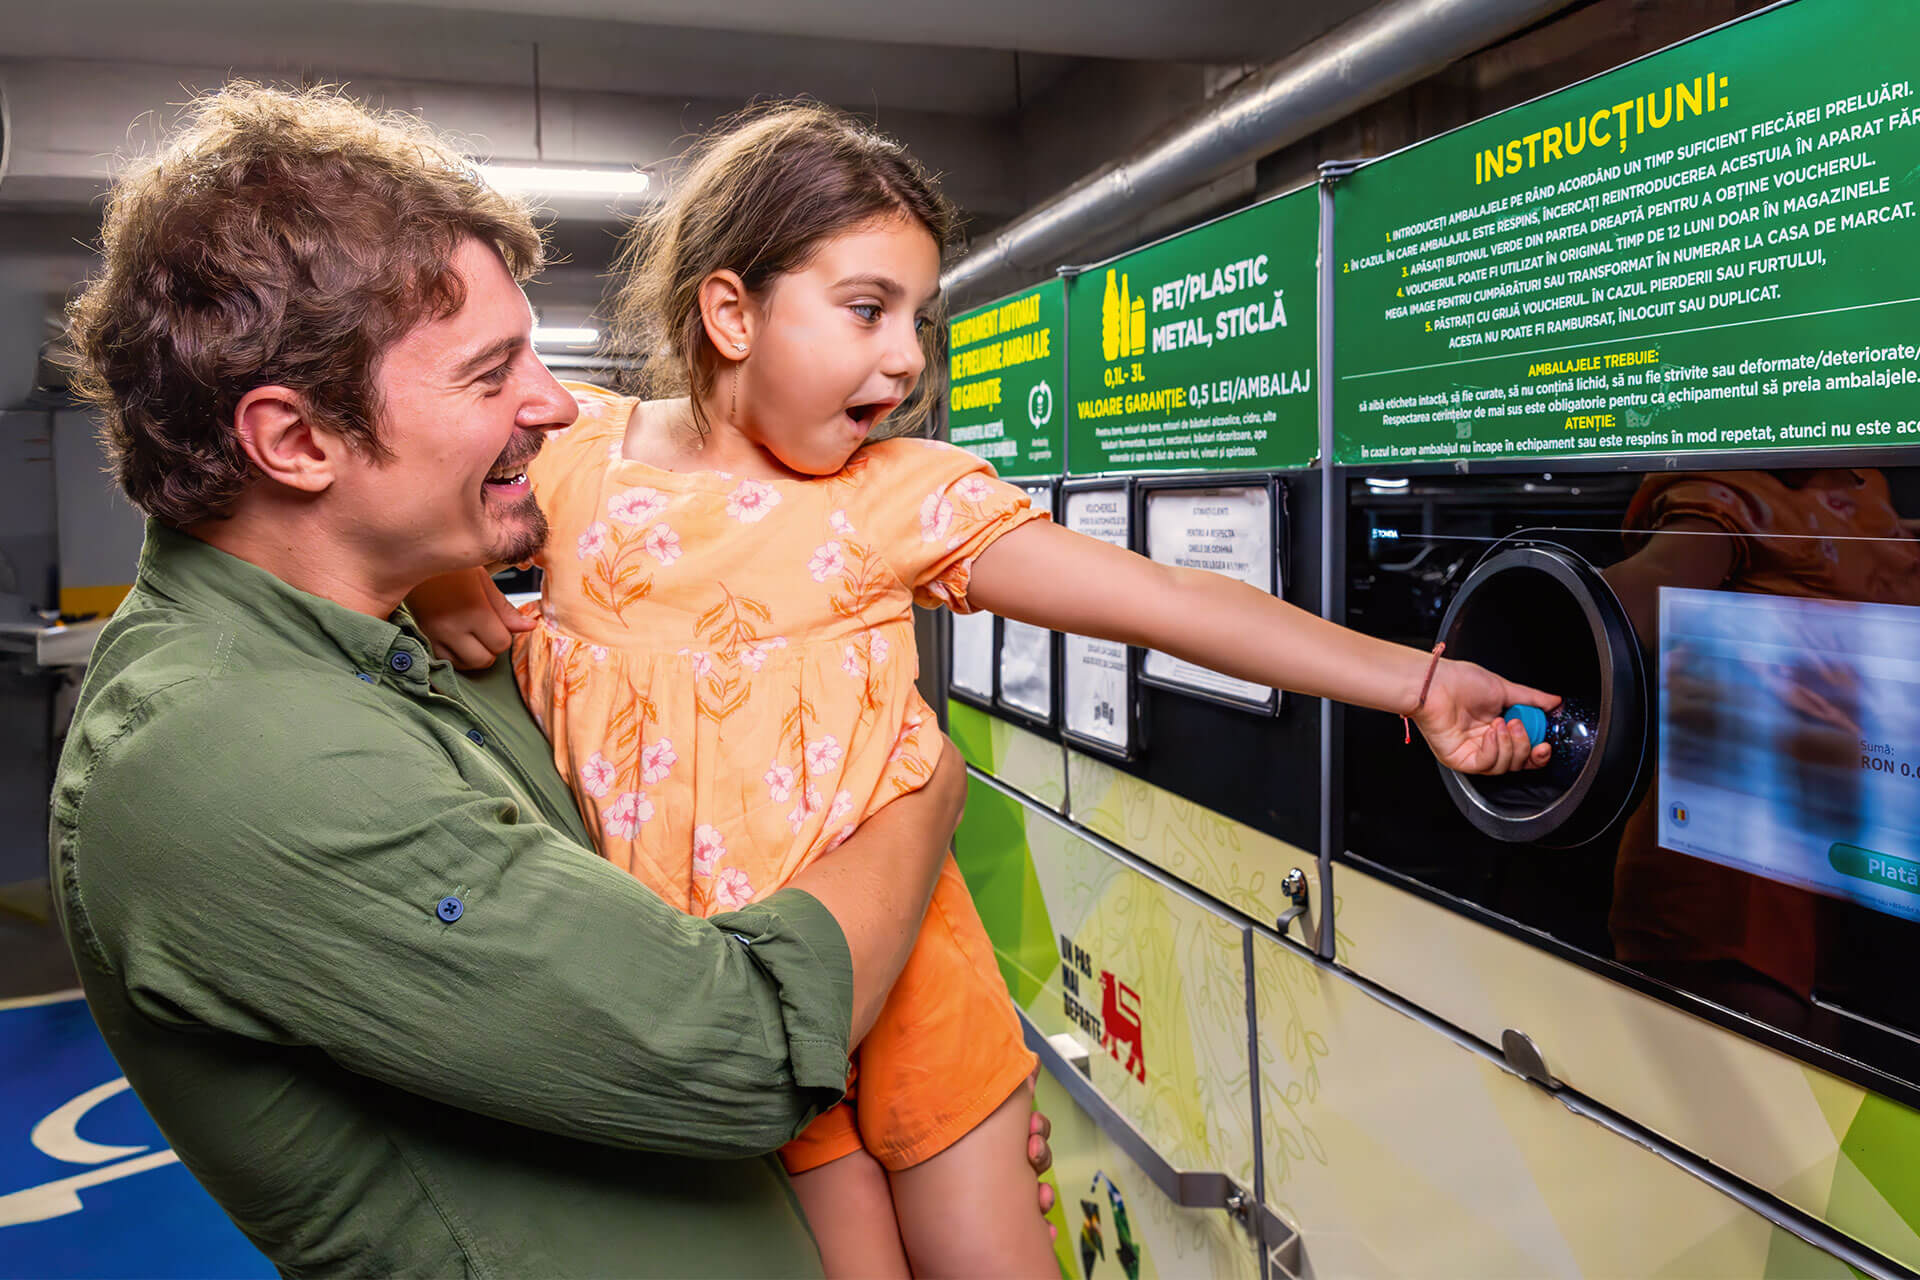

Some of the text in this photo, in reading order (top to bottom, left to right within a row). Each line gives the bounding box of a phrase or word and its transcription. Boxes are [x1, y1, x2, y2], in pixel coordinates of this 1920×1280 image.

[1475, 71, 1728, 184] INSTRUCȚIUNI:
[1392, 215, 1446, 240] INTRODUCEȚI
[1448, 197, 1508, 224] AMBALAJELE
[1510, 193, 1523, 207] PE
[1525, 184, 1555, 203] RÂND
[1557, 165, 1621, 194] ACORDÂND
[1623, 159, 1641, 175] UN
[1643, 149, 1674, 169] TIMP
[1677, 127, 1747, 160] SUFICIENT
[1751, 106, 1820, 139] FIECĂREI
[1825, 80, 1913, 119] PRELUĂRI.
[1350, 258, 1359, 271] ÎN
[1359, 253, 1385, 268] CAZUL
[1386, 249, 1394, 261] ÎN
[1395, 243, 1417, 259] CARE
[1419, 230, 1471, 253] AMBALAJUL
[1472, 223, 1495, 239] ESTE
[1497, 211, 1540, 232] RESPINS,
[1542, 194, 1599, 221] ÎNCERCAȚI
[1602, 164, 1716, 205] REINTRODUCEREA
[1720, 143, 1792, 175] ACESTUIA
[1795, 136, 1812, 155] ÎN
[1817, 117, 1884, 150] APARAT
[1410, 257, 1444, 275] APĂSAȚI
[1446, 247, 1489, 267] BUTONUL
[1490, 237, 1523, 255] VERDE
[1525, 232, 1543, 248] DIN
[1545, 222, 1587, 242] PARTEA
[1590, 204, 1644, 232] DREAPTĂ
[1647, 194, 1698, 218] PENTRU
[1702, 191, 1712, 206] A
[1715, 176, 1769, 202] OBȚINE
[1773, 151, 1875, 188] VOUCHERUL.
[1385, 201, 1916, 319] MEGA IMAGE PENTRU CUMPĂRĂTURI SAU TRANSFORMAT ÎN NUMERAR LA CASA DE MARCAT.
[1405, 275, 1456, 296] VOUCHERUL
[1457, 268, 1487, 284] POATE
[1489, 265, 1498, 278] FI
[1500, 255, 1544, 275] UTILIZAT
[1545, 250, 1557, 265] ÎN
[1559, 239, 1613, 262] ORIGINAL
[1615, 236, 1644, 250] TIMP
[1647, 227, 1664, 243] DE
[1667, 224, 1680, 239] 12
[1684, 216, 1714, 235] LUNI
[1718, 206, 1759, 228] DOAR
[1762, 200, 1778, 218] ÎN
[1783, 176, 1889, 214] MAGAZINELE
[1152, 254, 1268, 312] PET/PLASTIC
[1434, 313, 1474, 330] PĂSTRAȚI
[1476, 310, 1490, 323] CU
[1491, 302, 1520, 320] GRIJĂ
[1522, 293, 1589, 314] VOUCHERUL.
[1591, 287, 1604, 302] ÎN
[1606, 281, 1647, 300] CAZUL
[1650, 269, 1712, 292] PIERDERII
[1716, 263, 1744, 281] SAU
[1748, 248, 1826, 275] FURTULUI,
[1152, 289, 1287, 353] METAL, STICLĂ
[1448, 284, 1781, 348] ACESTA NU POATE FI RAMBURSAT, ÎNLOCUIT SAU DUPLICAT.
[1130, 362, 1145, 382] 3L
[1450, 390, 1460, 403] să
[1461, 389, 1473, 401] fie
[1475, 387, 1506, 400] curate,
[1508, 384, 1518, 397] să
[1521, 385, 1533, 395] nu
[1535, 378, 1574, 396] conțină
[1576, 374, 1609, 390] lichid,
[1611, 373, 1624, 387] să
[1627, 374, 1642, 385] nu
[1645, 369, 1661, 384] fie
[1664, 365, 1708, 382] strivite
[1711, 364, 1735, 377] sau
[1528, 349, 1659, 376] AMBALAJELE TREBUIE:
[1077, 368, 1310, 419] VALOARE GARANȚIE: 0,5 LEI/AMBALAJ
[1431, 407, 1472, 423] cerințelor
[1473, 405, 1486, 418] de
[1487, 403, 1505, 416] mai
[1506, 404, 1523, 415] sus
[1524, 401, 1546, 414] este
[1547, 395, 1606, 413] obligatorie
[1609, 392, 1647, 409] pentru
[1650, 392, 1664, 404] ca
[1668, 380, 1758, 403] echipamentul
[1762, 378, 1778, 395] să
[1782, 375, 1820, 396] preia
[1825, 367, 1920, 390] ambalajele.
[1459, 444, 1471, 453] nu
[1472, 440, 1503, 453] încape
[1504, 438, 1514, 451] în
[1516, 436, 1575, 452] echipament
[1577, 437, 1596, 448] sau
[1599, 434, 1623, 447] este
[1626, 431, 1668, 447] respins
[1671, 429, 1683, 443] în
[1687, 427, 1716, 443] mod
[1721, 425, 1775, 444] repetat,
[1779, 421, 1826, 439] atunci
[1831, 423, 1850, 436] nu
[1856, 419, 1891, 435] este
[1564, 414, 1615, 432] ATENȚIE:
[1861, 755, 1894, 774] RON
[1869, 858, 1918, 886] Plată
